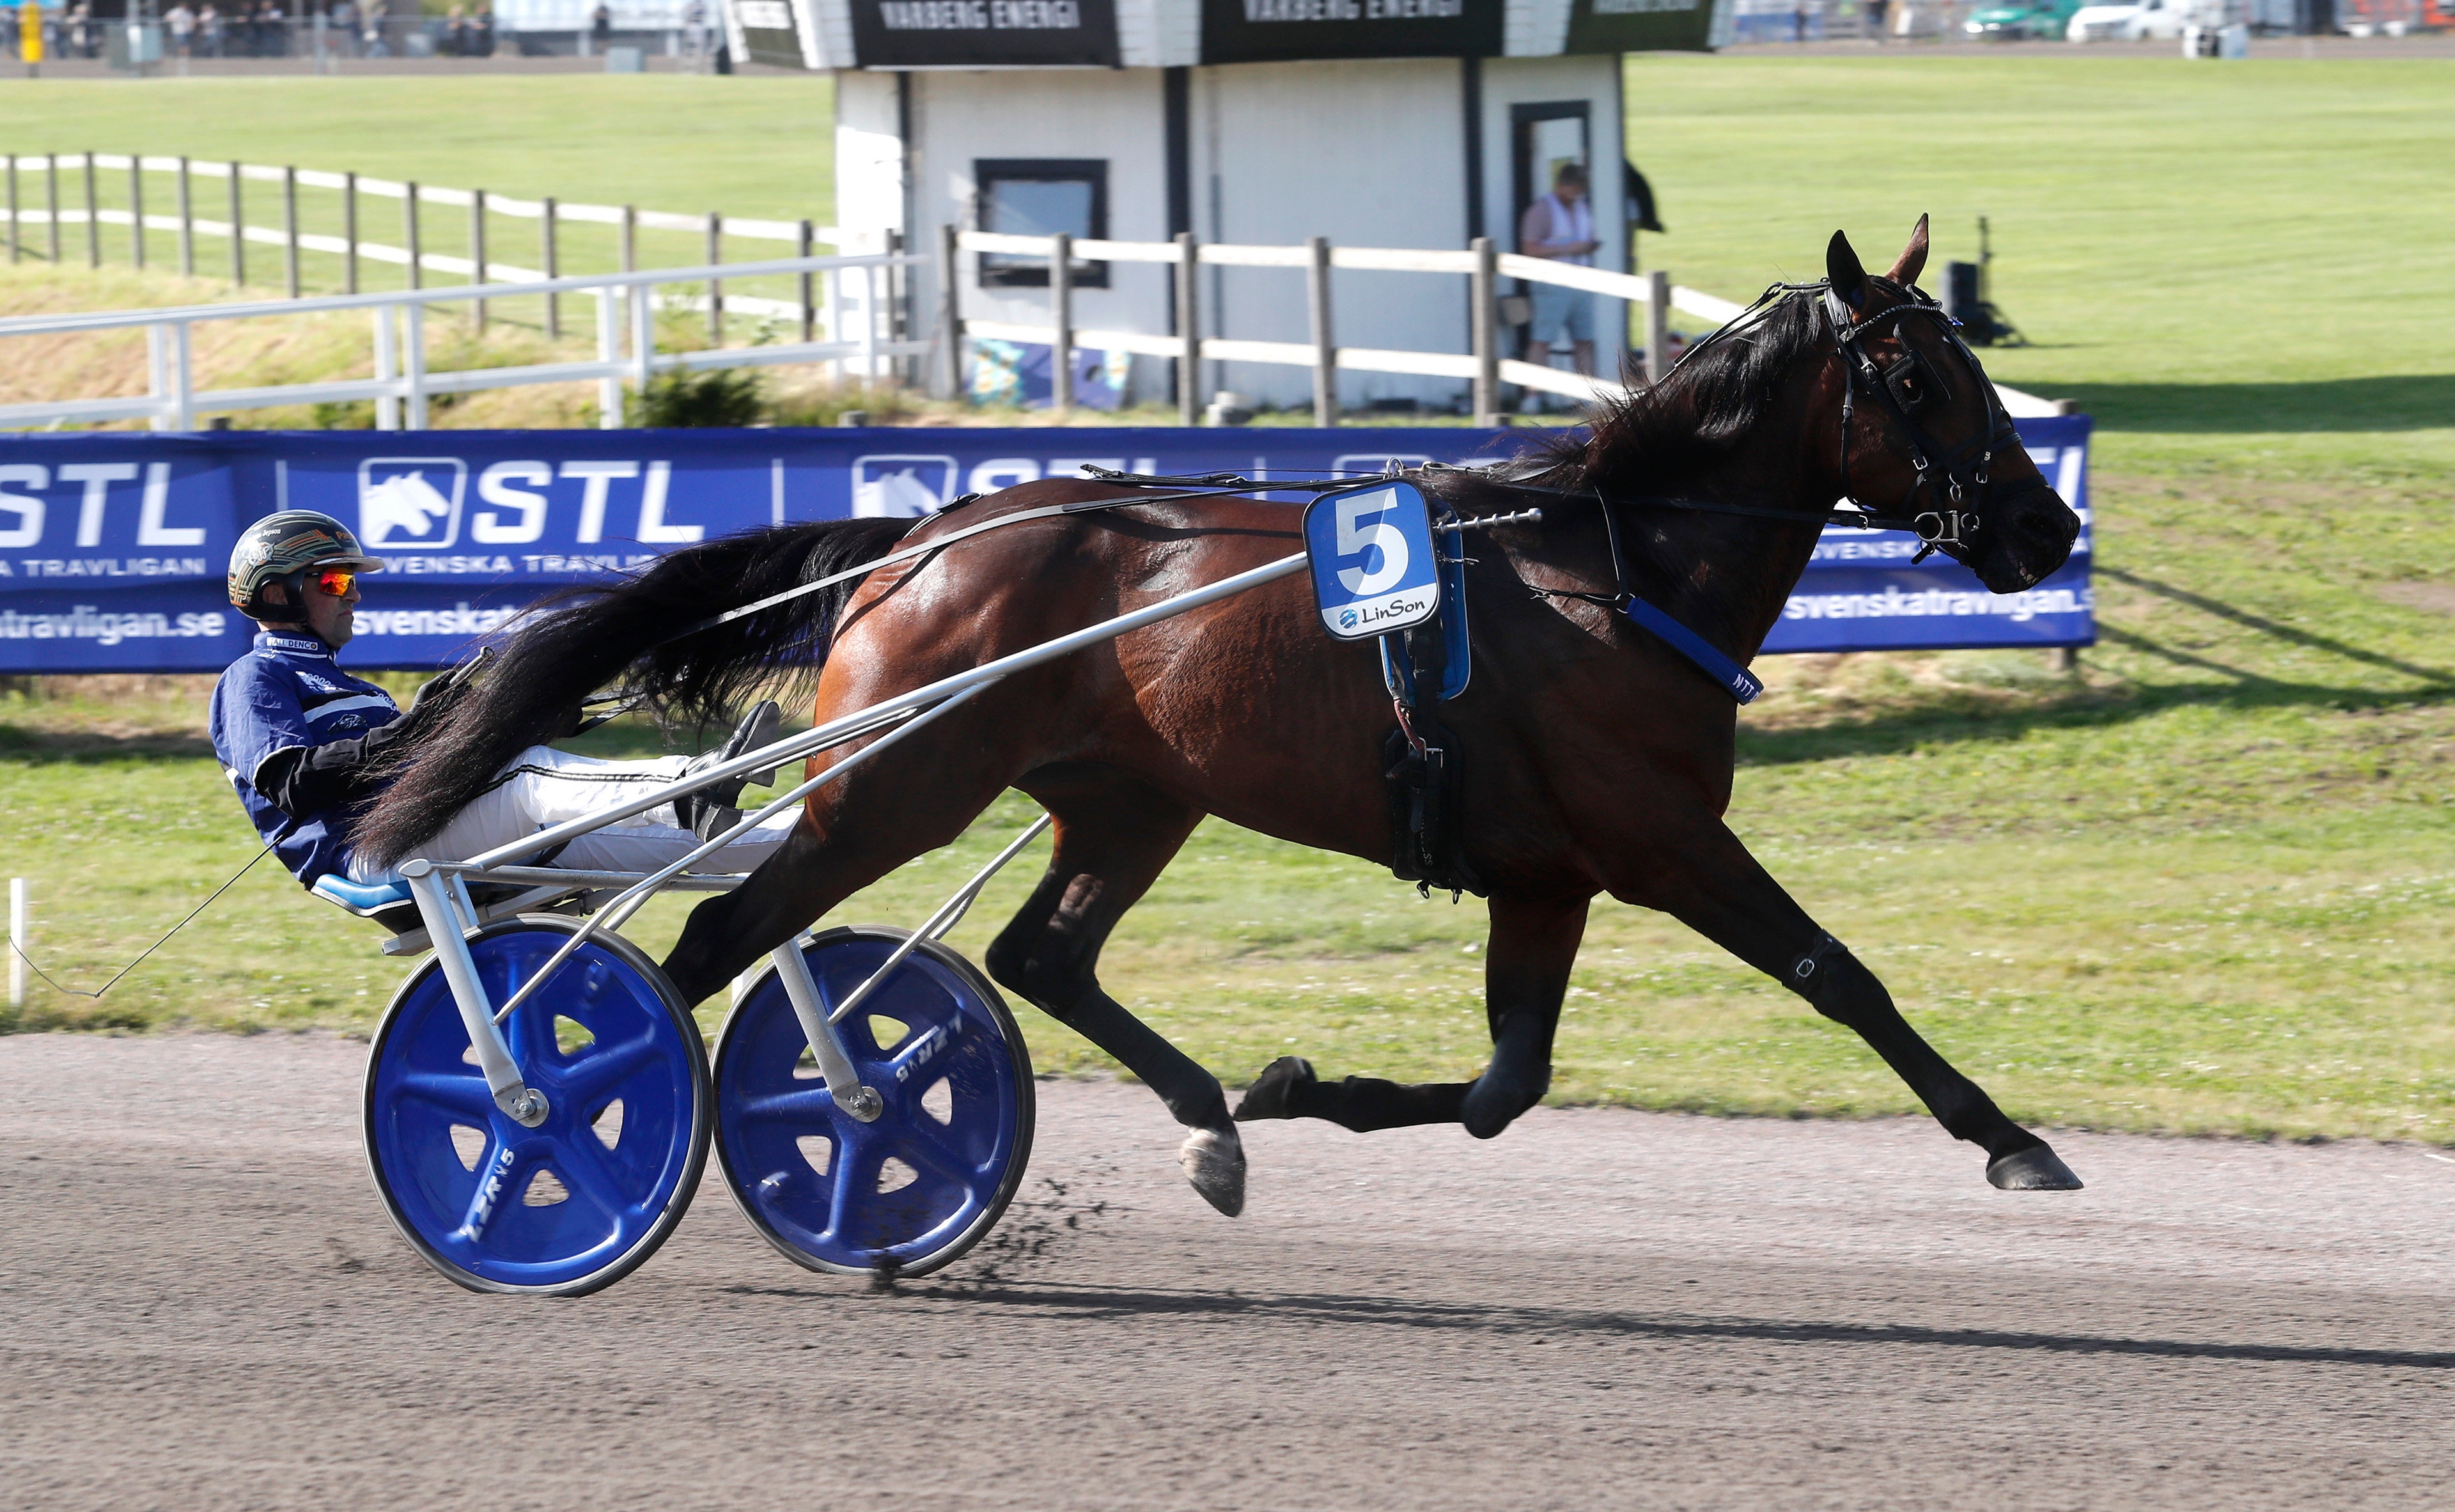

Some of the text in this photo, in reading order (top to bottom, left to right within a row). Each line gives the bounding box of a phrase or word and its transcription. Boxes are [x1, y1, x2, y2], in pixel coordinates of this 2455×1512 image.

[471, 460, 705, 544] STL
[1336, 487, 1409, 596] 5
[21, 558, 206, 577] TRAVLIGAN
[366, 556, 514, 574] VENSKA
[1361, 600, 1426, 623] LinSon
[0, 604, 226, 646] travligan.se
[288, 640, 317, 650] DENCO
[1732, 673, 1755, 697] NTT
[500, 1148, 515, 1166] 5
